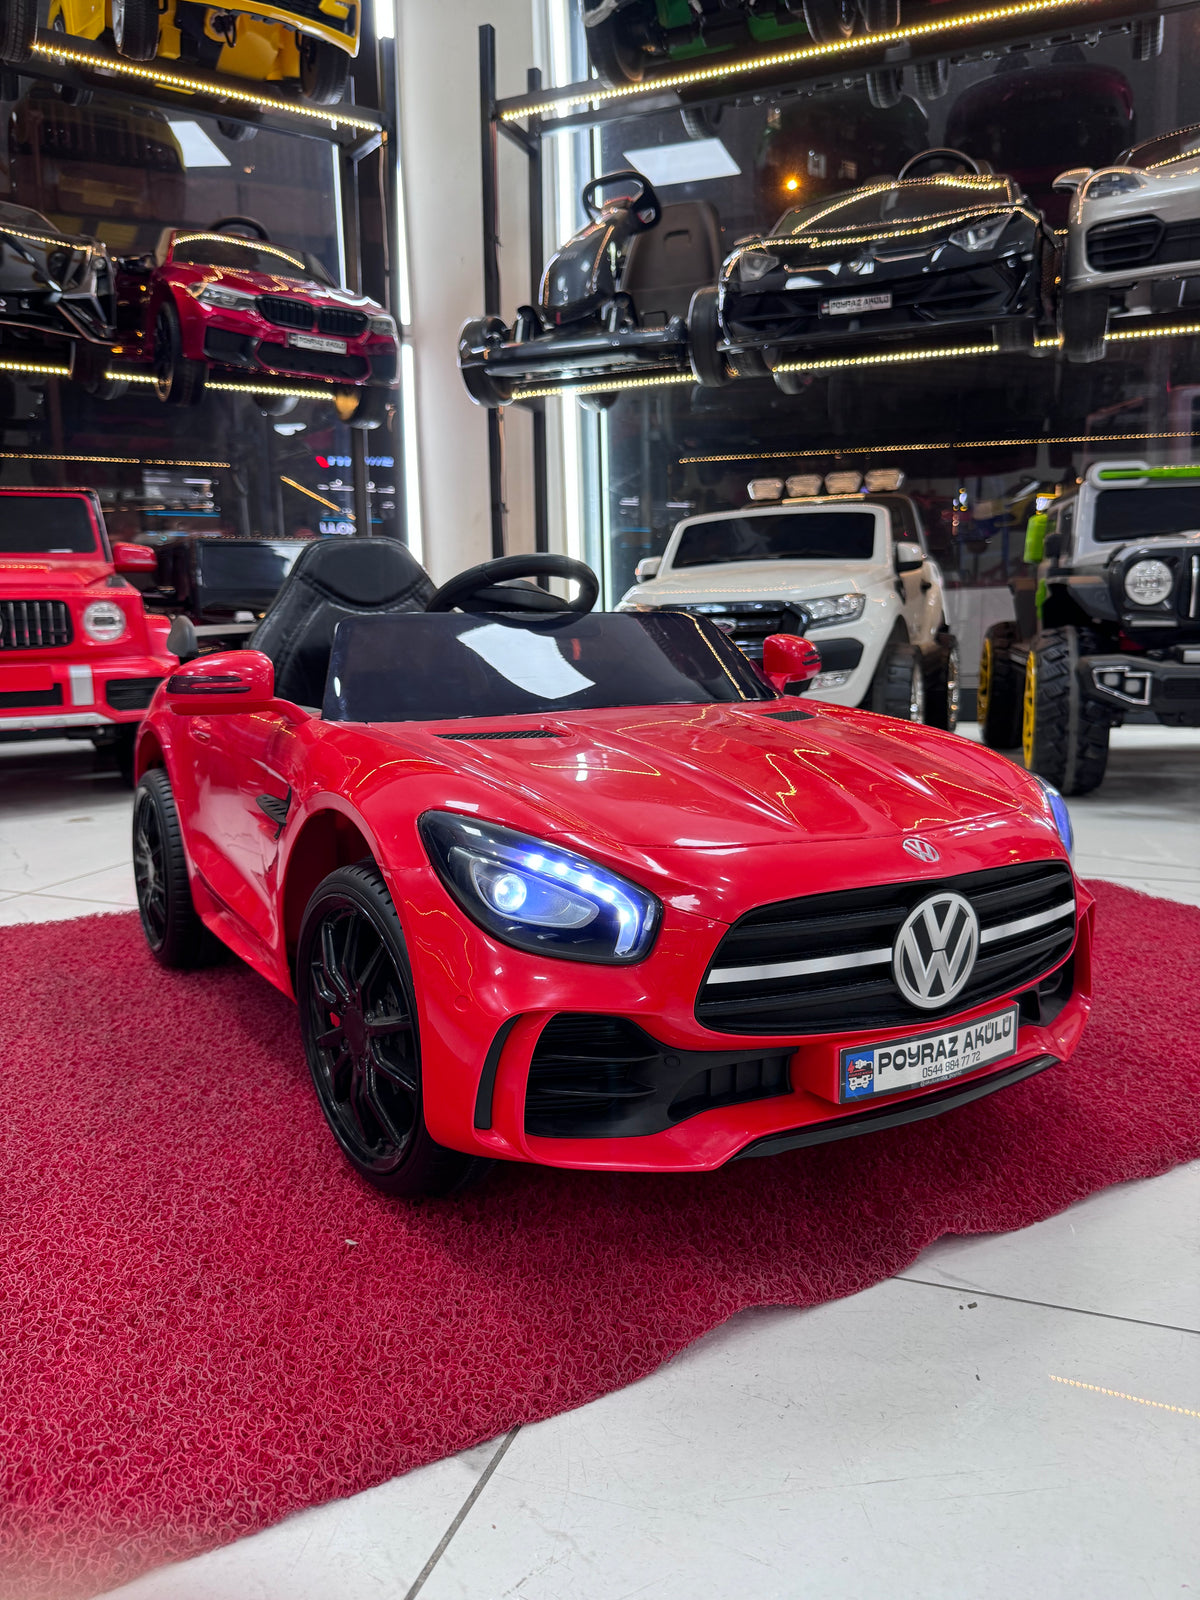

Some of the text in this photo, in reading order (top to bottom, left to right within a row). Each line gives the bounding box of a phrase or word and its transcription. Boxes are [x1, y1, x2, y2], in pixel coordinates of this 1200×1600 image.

[878, 1015, 1012, 1075] POYRAZ AKÜLÜ
[922, 1063, 943, 1079] 0544
[944, 1058, 960, 1072] 884
[960, 1054, 971, 1067] 77
[971, 1050, 981, 1062] 72
